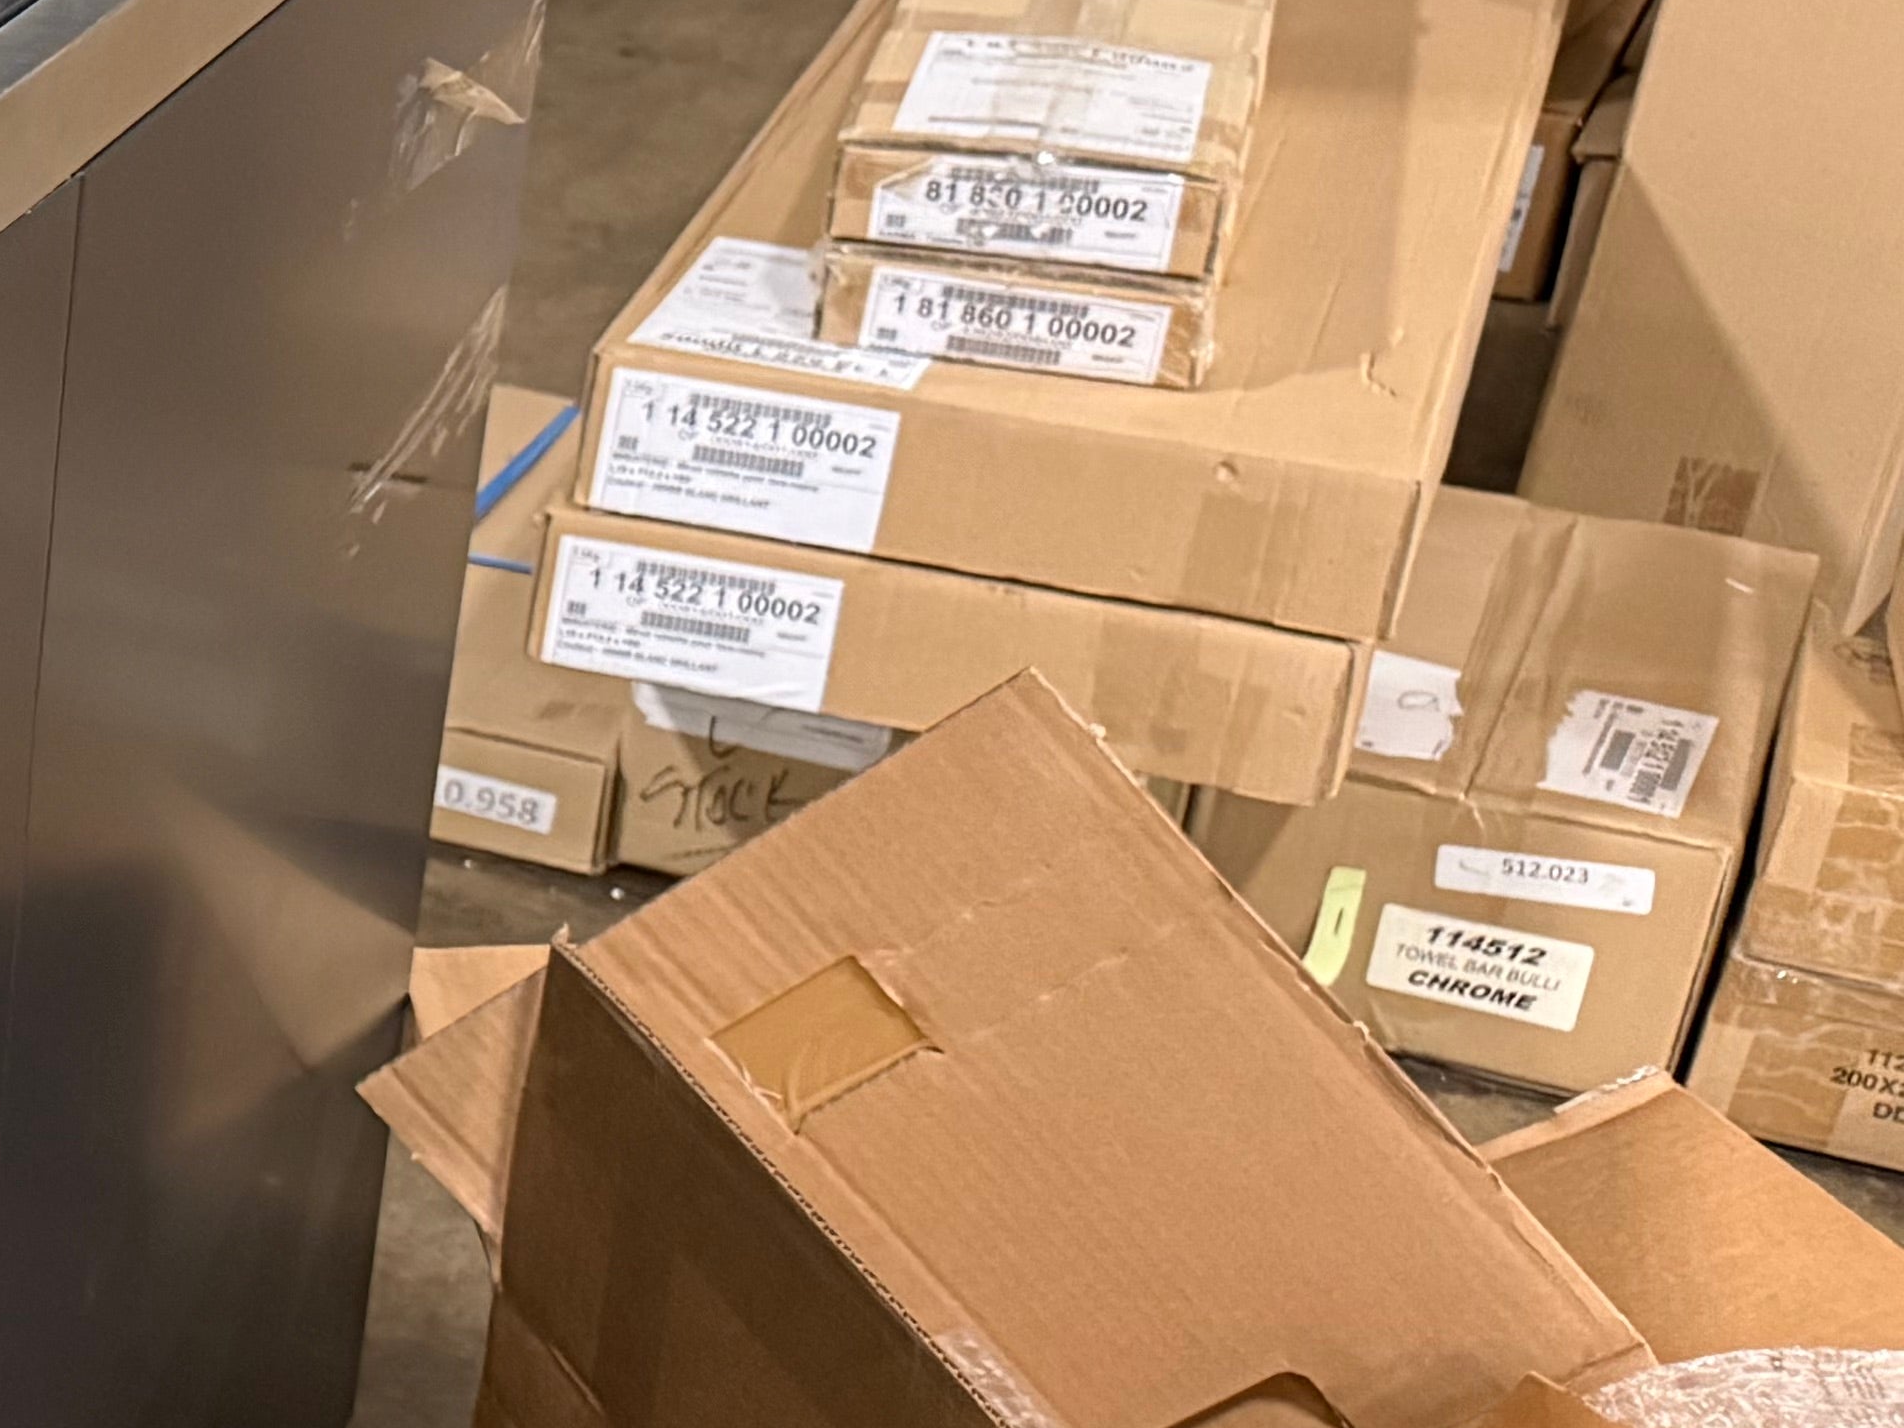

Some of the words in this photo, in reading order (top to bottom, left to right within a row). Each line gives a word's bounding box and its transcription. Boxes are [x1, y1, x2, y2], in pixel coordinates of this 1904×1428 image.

[926, 180, 957, 202] 81
[895, 294, 905, 314] 1
[917, 297, 948, 320] 81
[960, 302, 1012, 328] 860
[1025, 313, 1035, 334] 1
[1048, 317, 1136, 348] 00002
[642, 401, 655, 421] 1
[668, 404, 697, 427] 14
[706, 410, 757, 440] 522
[769, 421, 780, 441] 1
[791, 426, 878, 458] 00002
[591, 568, 601, 588] 1
[614, 571, 644, 593] 14
[654, 578, 703, 605] 522
[715, 589, 726, 608] 1
[737, 592, 821, 624] 00002
[1501, 858, 1589, 885] 512.023
[1396, 943, 1459, 972] TOWEL
[1463, 959, 1504, 980] BAR
[1506, 969, 1561, 992] BULLI
[1425, 926, 1547, 966] 114512
[1408, 969, 1538, 1011] CHROME
